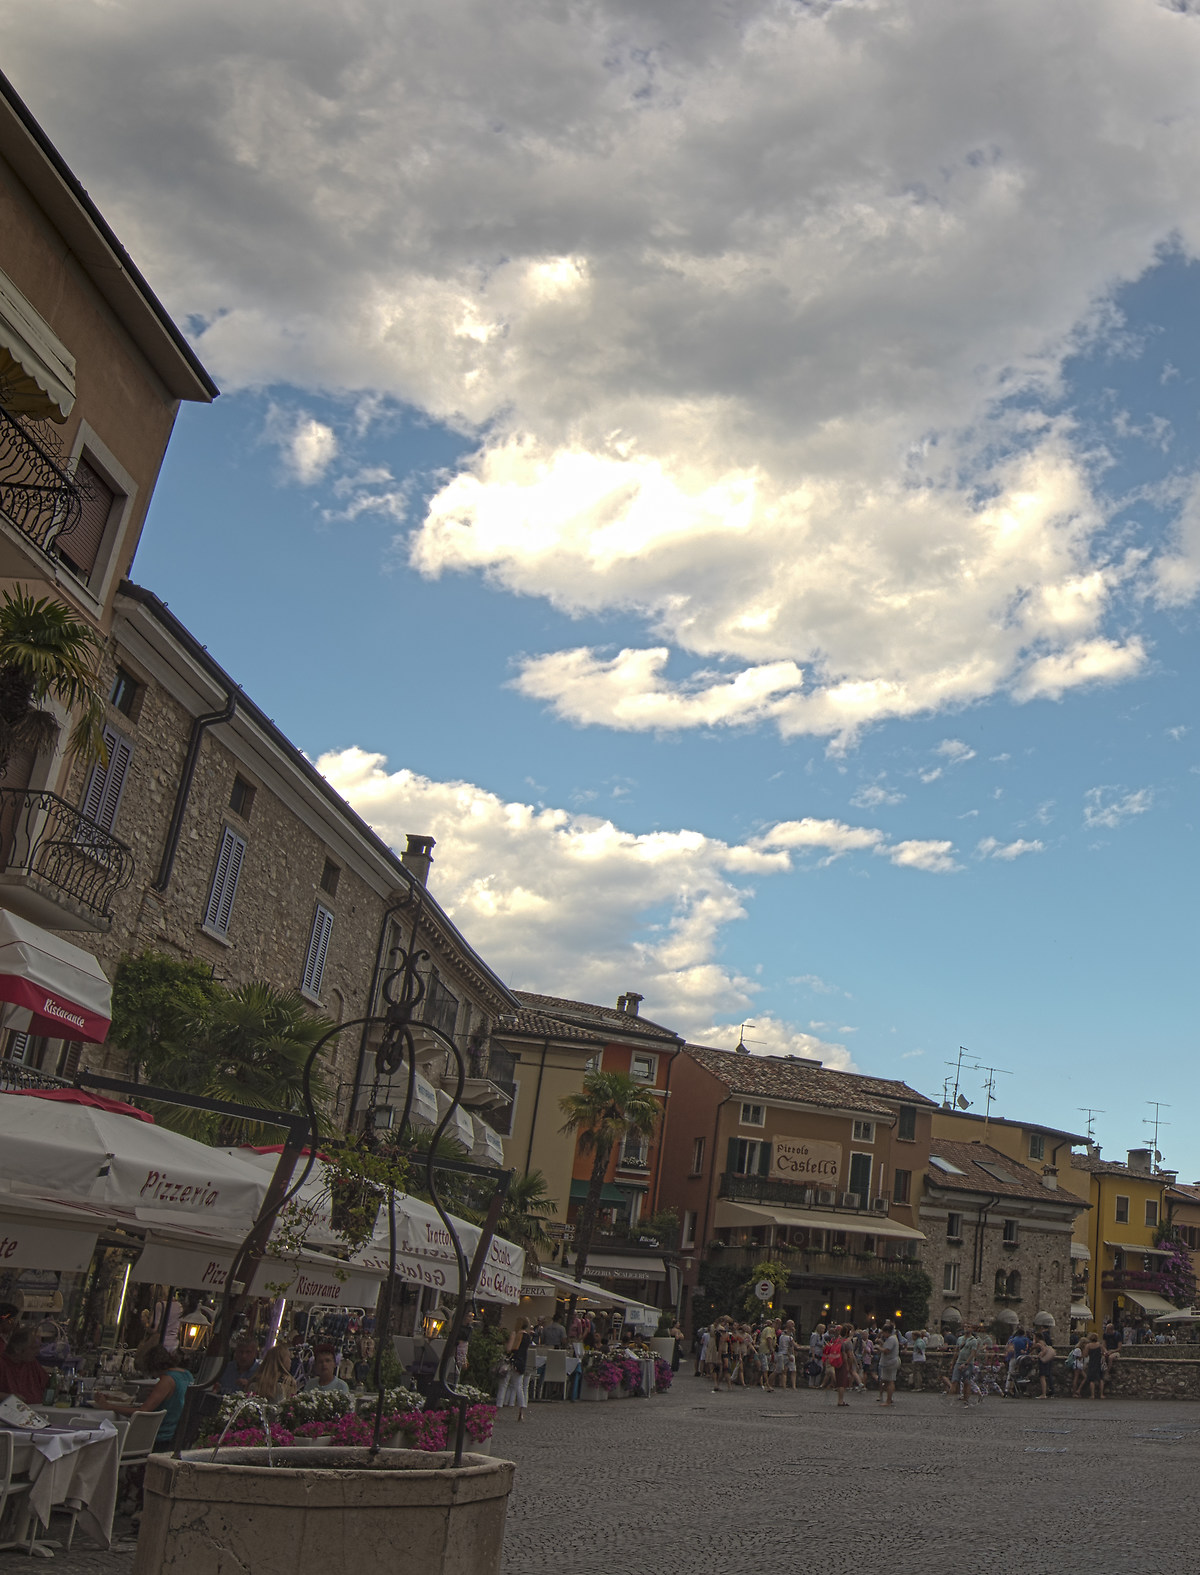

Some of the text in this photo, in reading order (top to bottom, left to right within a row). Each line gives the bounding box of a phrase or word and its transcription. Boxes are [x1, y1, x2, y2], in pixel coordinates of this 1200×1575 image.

[43, 998, 85, 1028] Ristorante
[777, 1155, 837, 1175] Castello
[139, 1169, 221, 1208] Pizzeria
[202, 1261, 228, 1285] Pizz
[296, 1276, 342, 1300] Ristorante
[520, 1287, 546, 1296] ZERIA
